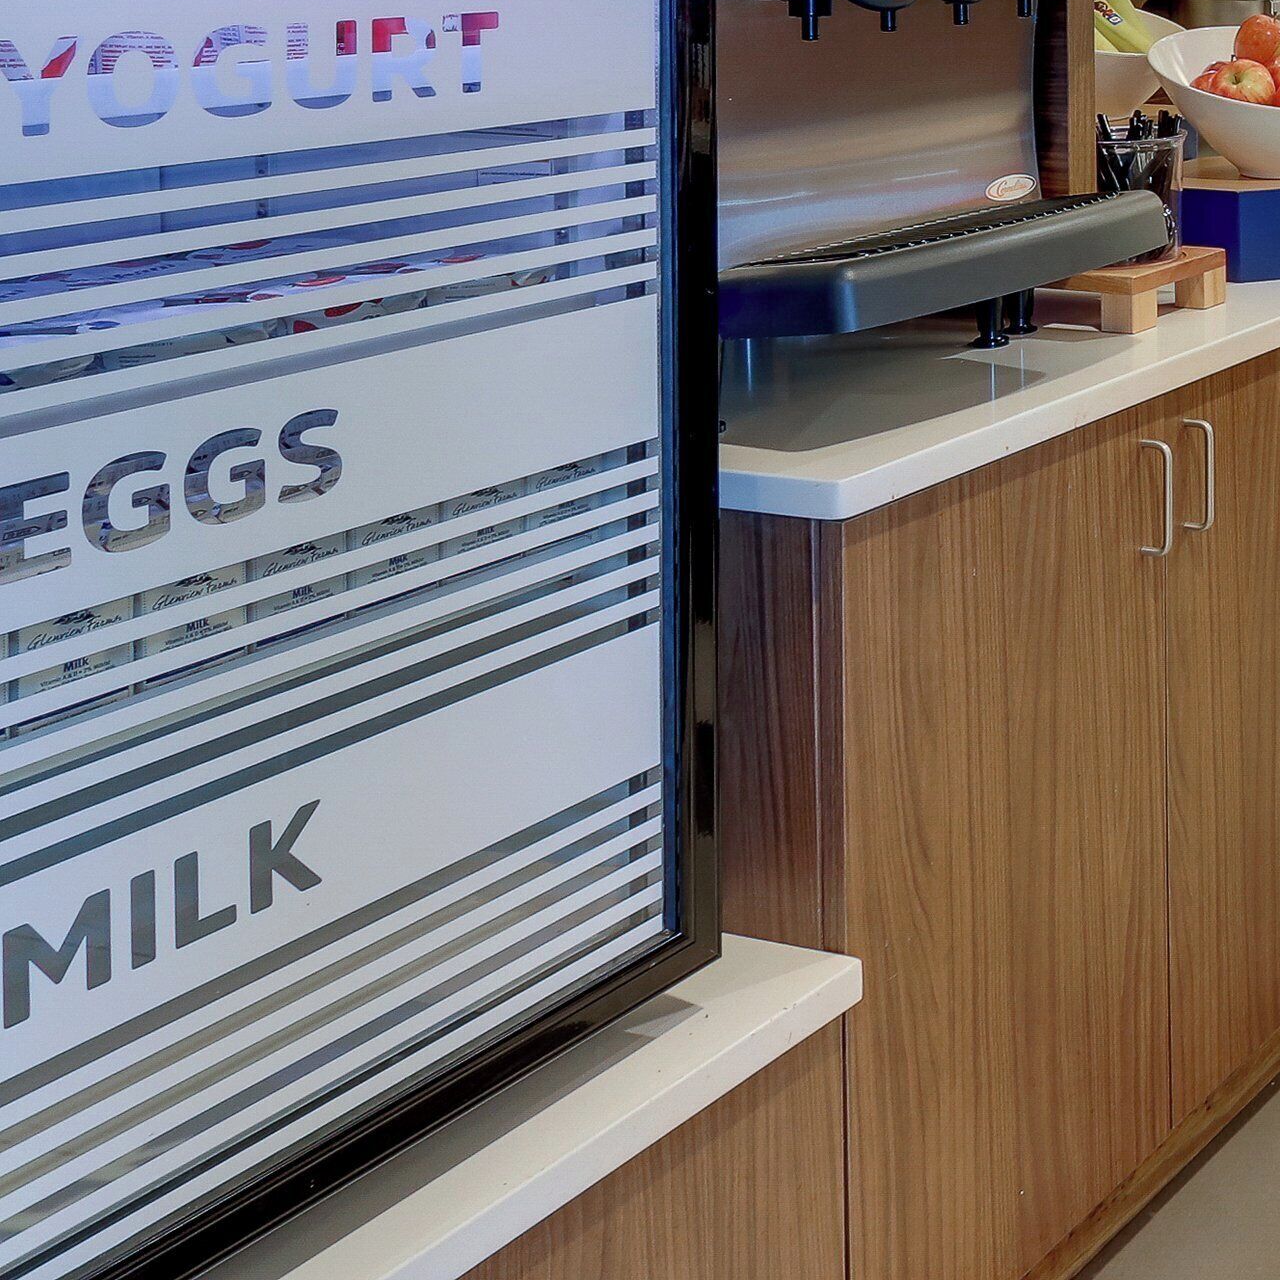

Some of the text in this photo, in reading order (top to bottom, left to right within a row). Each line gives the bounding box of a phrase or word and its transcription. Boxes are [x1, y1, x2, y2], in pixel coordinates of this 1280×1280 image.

[0, 10, 500, 136] YOGURT
[0, 408, 343, 586] EGGS
[185, 616, 210, 632] Milk
[292, 584, 314, 599] Milk
[63, 656, 90, 673] Milk
[2, 798, 323, 1029] MILK
